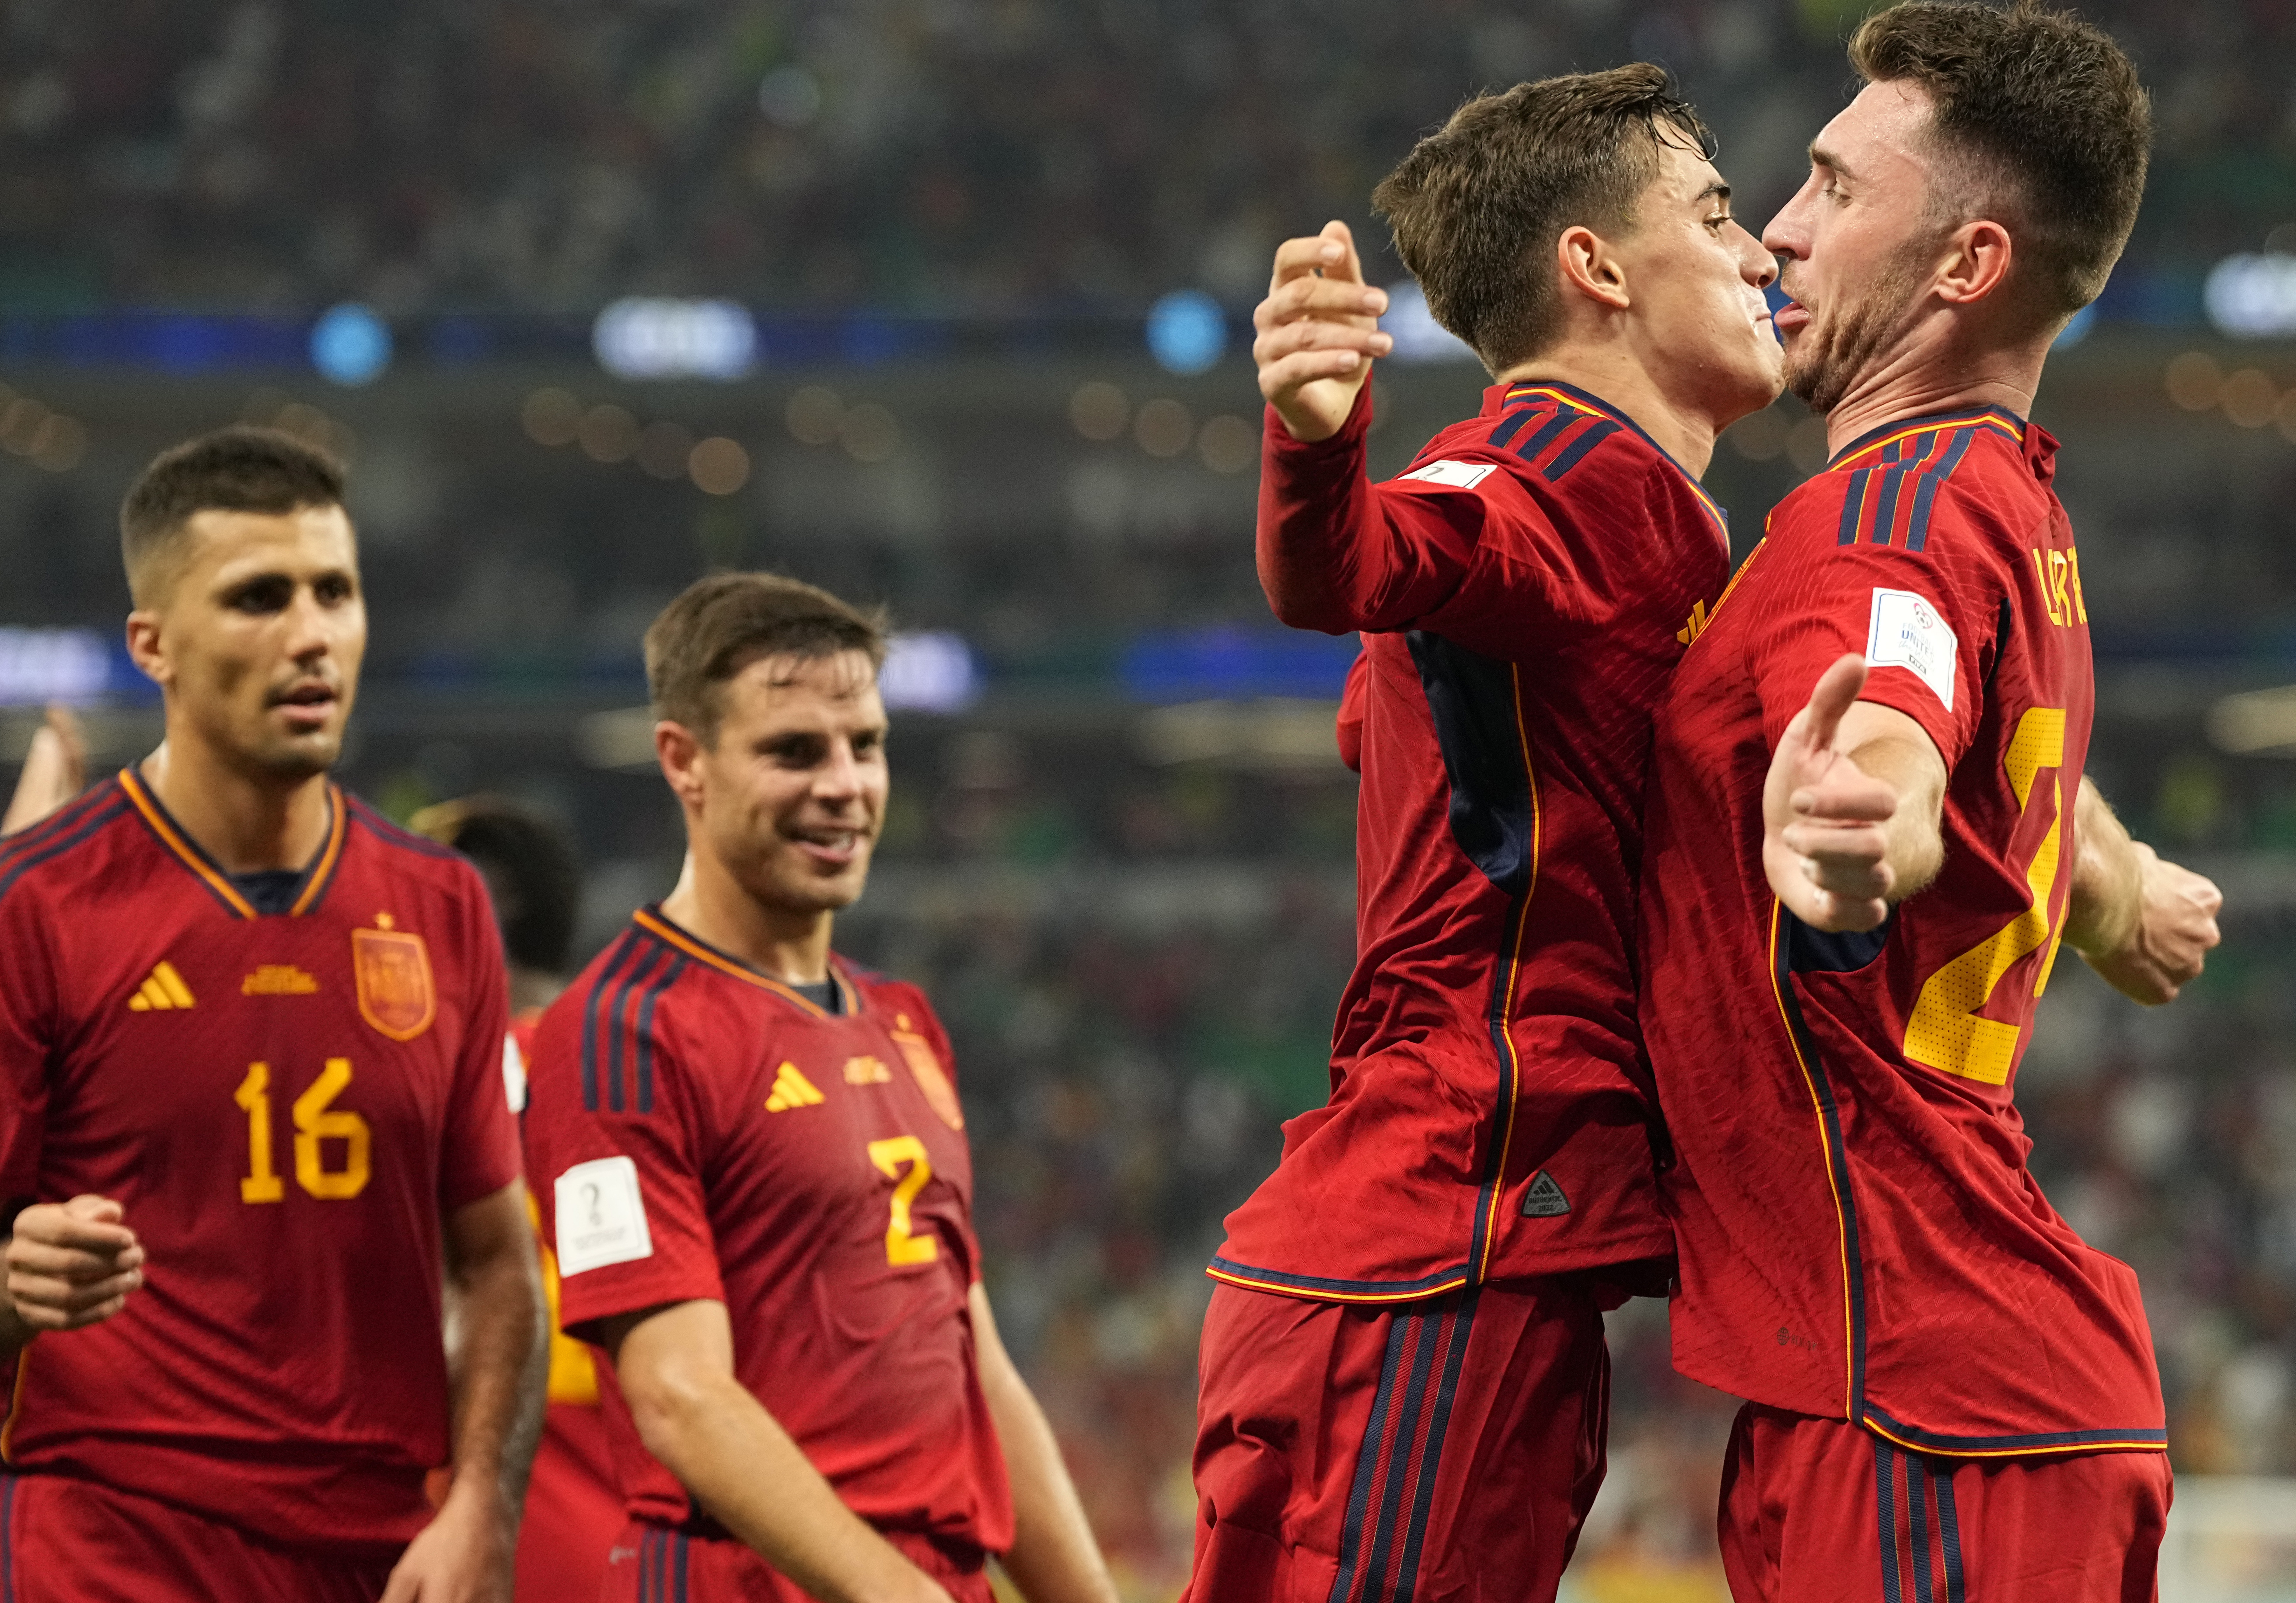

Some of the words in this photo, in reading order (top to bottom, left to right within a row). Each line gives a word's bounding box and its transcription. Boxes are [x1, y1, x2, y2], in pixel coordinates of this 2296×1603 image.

[1902, 630, 1934, 664] UNITES
[234, 1057, 371, 1204] 16
[867, 1135, 937, 1268] 2
[1528, 1195, 1562, 1204] AUTHENTIC
